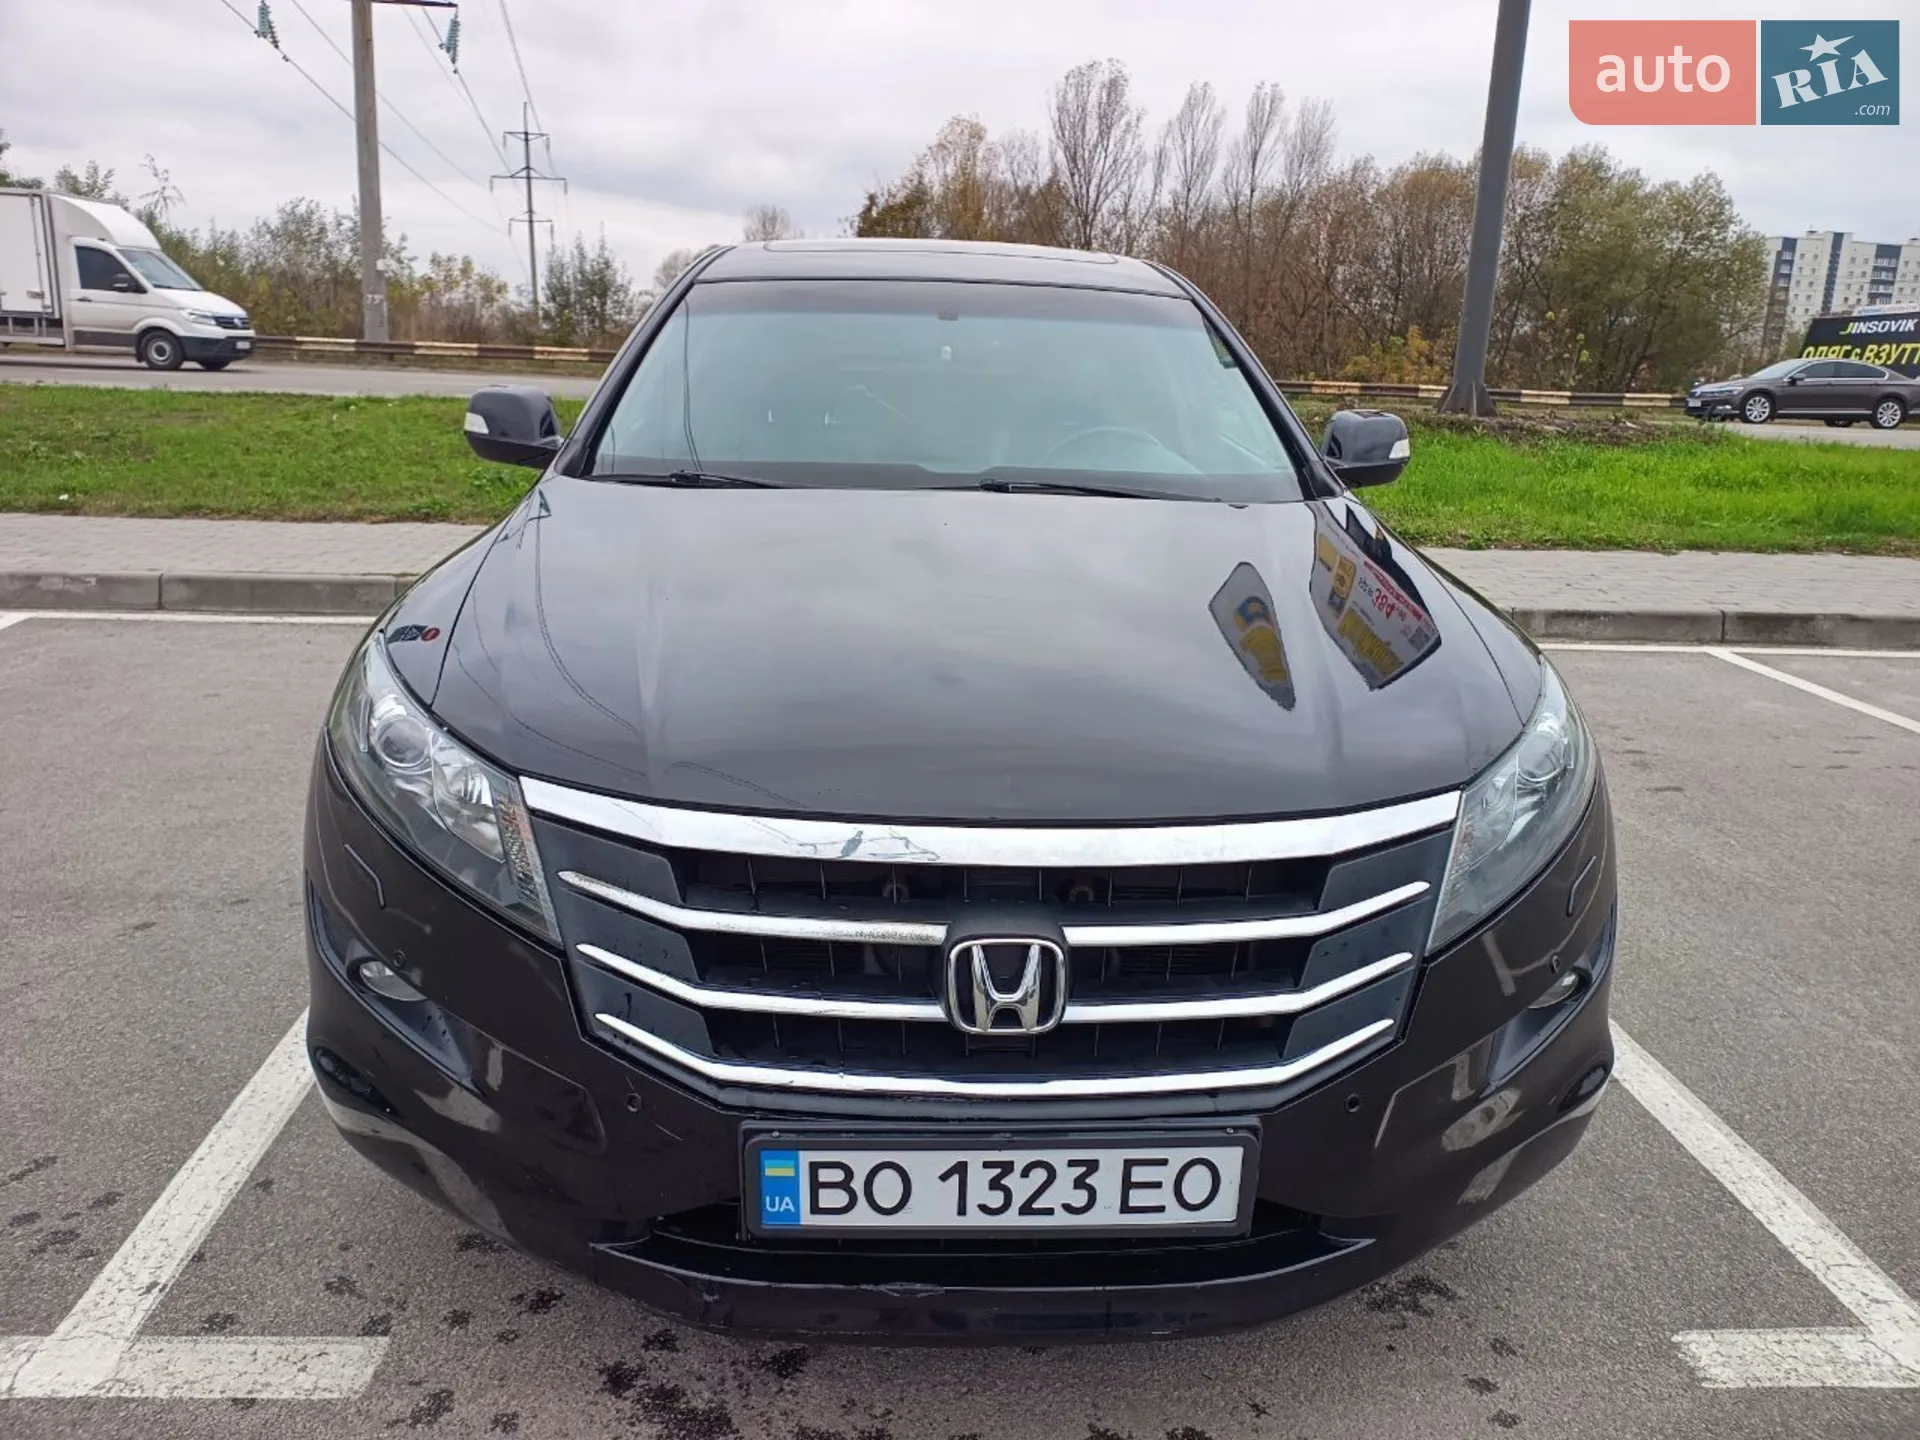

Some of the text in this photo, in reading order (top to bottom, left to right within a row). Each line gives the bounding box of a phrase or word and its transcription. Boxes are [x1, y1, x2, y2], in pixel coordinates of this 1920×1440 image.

[1839, 318, 1918, 335] JINSOVIK
[808, 1157, 1222, 1217] BO 1323 EO
[765, 1195, 796, 1213] UA
